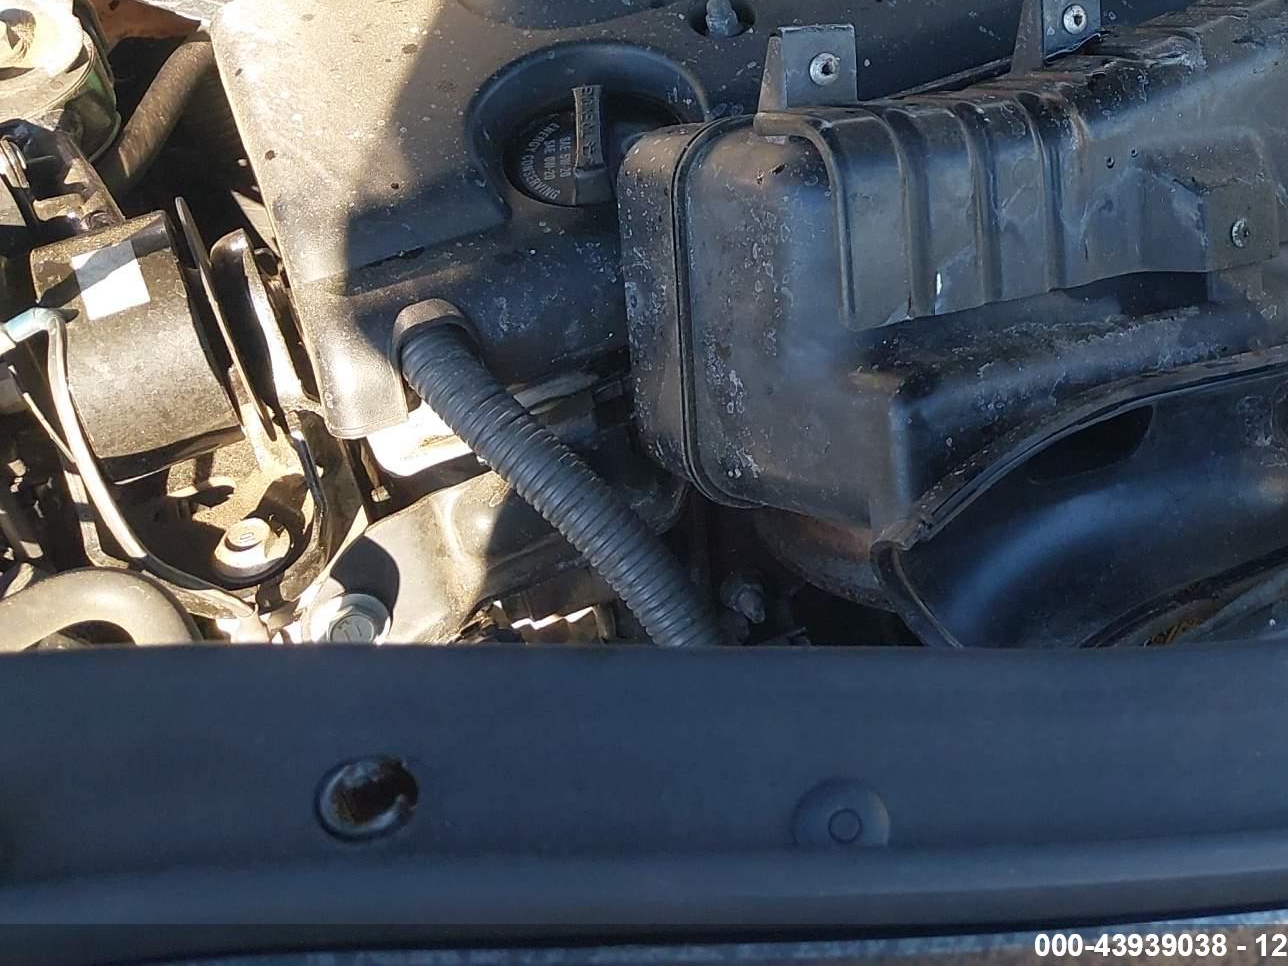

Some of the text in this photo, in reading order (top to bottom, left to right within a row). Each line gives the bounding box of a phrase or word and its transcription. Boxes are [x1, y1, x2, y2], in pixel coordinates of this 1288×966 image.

[543, 139, 556, 154] SAE
[559, 136, 572, 151] SAE
[520, 122, 561, 200] ENERGY CONSERVING
